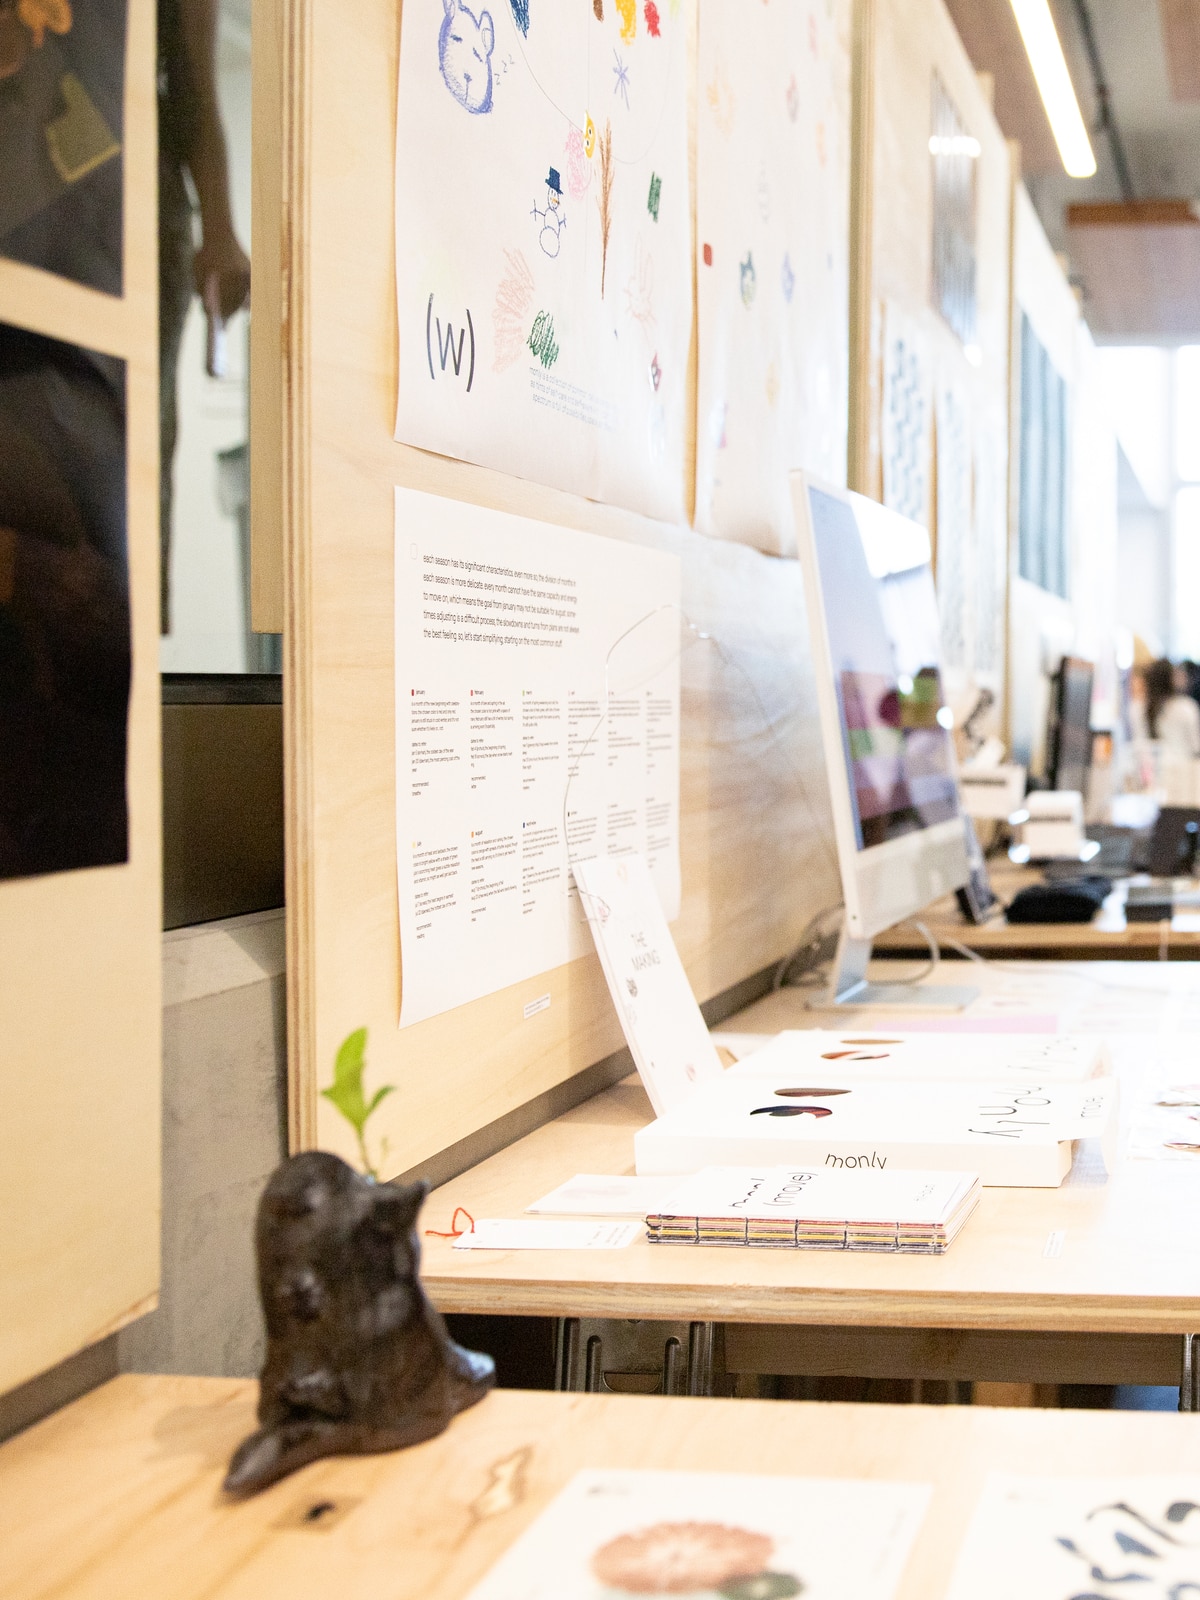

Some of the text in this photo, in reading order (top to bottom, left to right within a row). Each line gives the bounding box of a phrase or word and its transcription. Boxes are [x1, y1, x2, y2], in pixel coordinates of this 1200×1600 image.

[423, 554, 434, 563] each
[434, 557, 450, 566] season
[450, 558, 458, 567] has
[464, 560, 485, 574] significant
[423, 573, 434, 582] each
[434, 575, 450, 585] season
[455, 578, 466, 587] more
[429, 593, 441, 601] move
[462, 597, 476, 606] means
[484, 599, 492, 610] goal
[423, 610, 436, 620] times
[436, 612, 456, 624] adjusting
[464, 614, 479, 624] difficult
[423, 628, 431, 637] the
[431, 629, 441, 638] best
[472, 632, 482, 641] start
